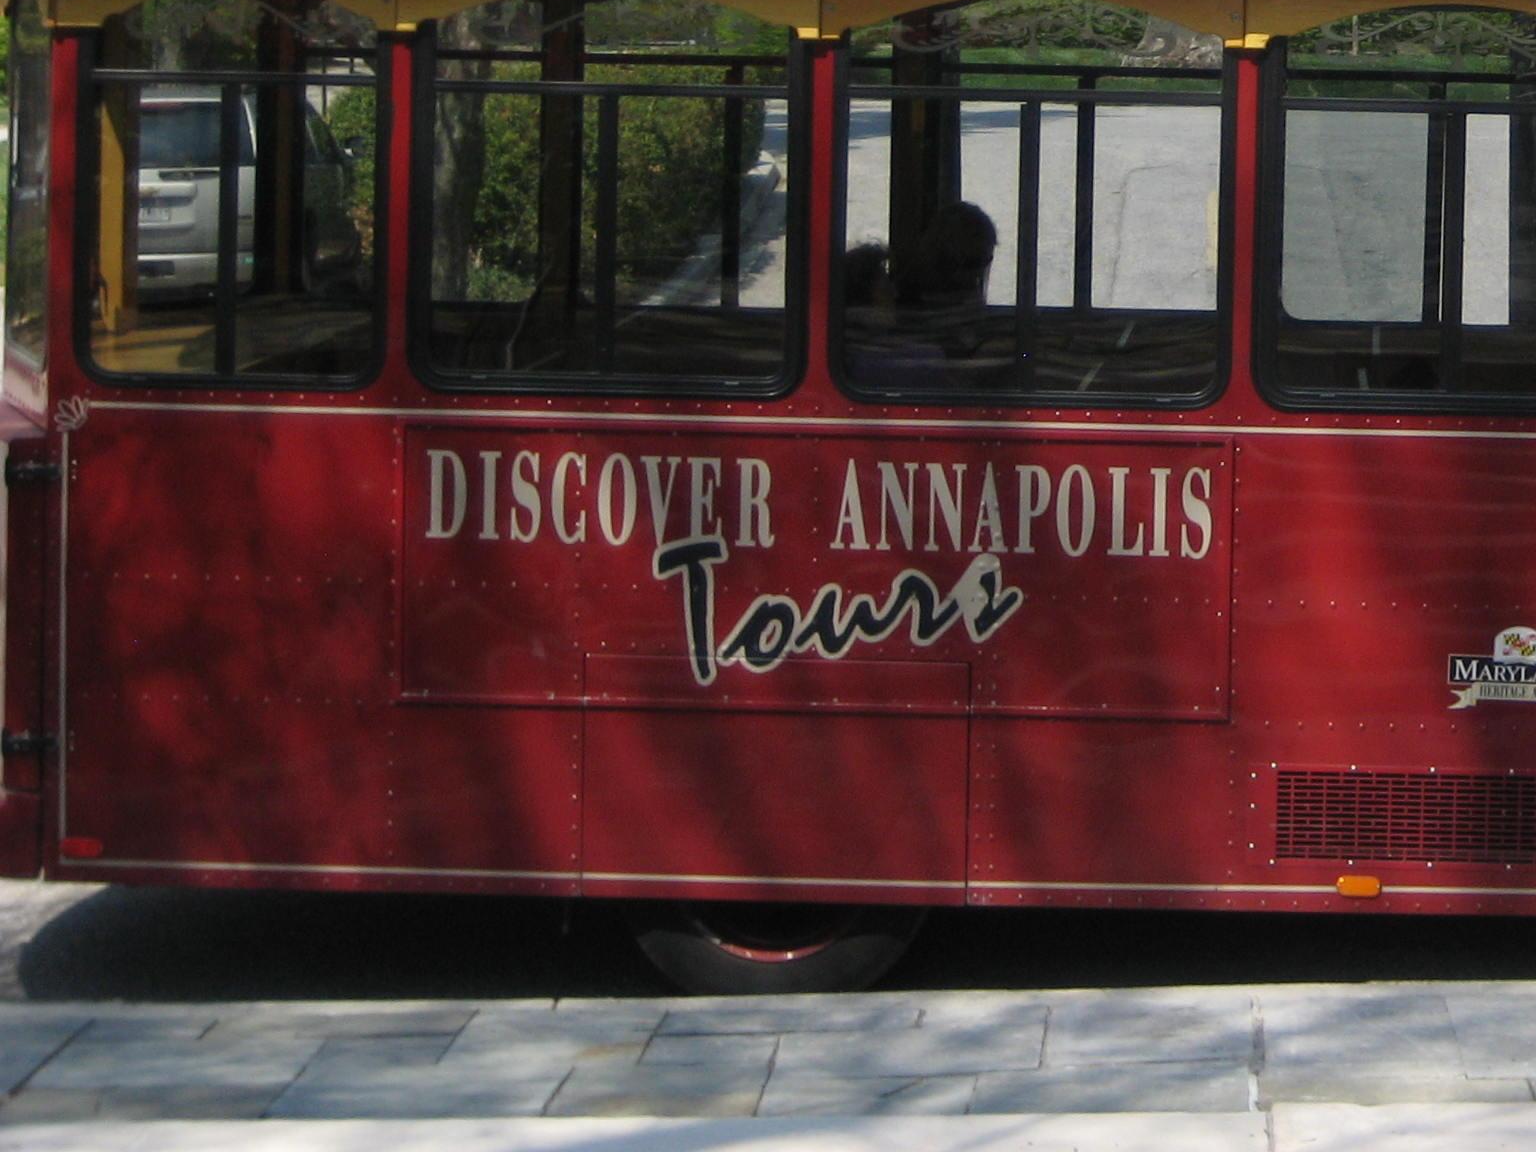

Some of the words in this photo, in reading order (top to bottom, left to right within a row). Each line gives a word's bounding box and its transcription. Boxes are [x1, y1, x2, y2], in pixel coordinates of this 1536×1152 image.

[425, 448, 775, 548] DISCOVER
[829, 458, 1213, 559] ANNAPOLIS
[653, 536, 1024, 686] Tours
[1479, 685, 1527, 697] HERITAGE
